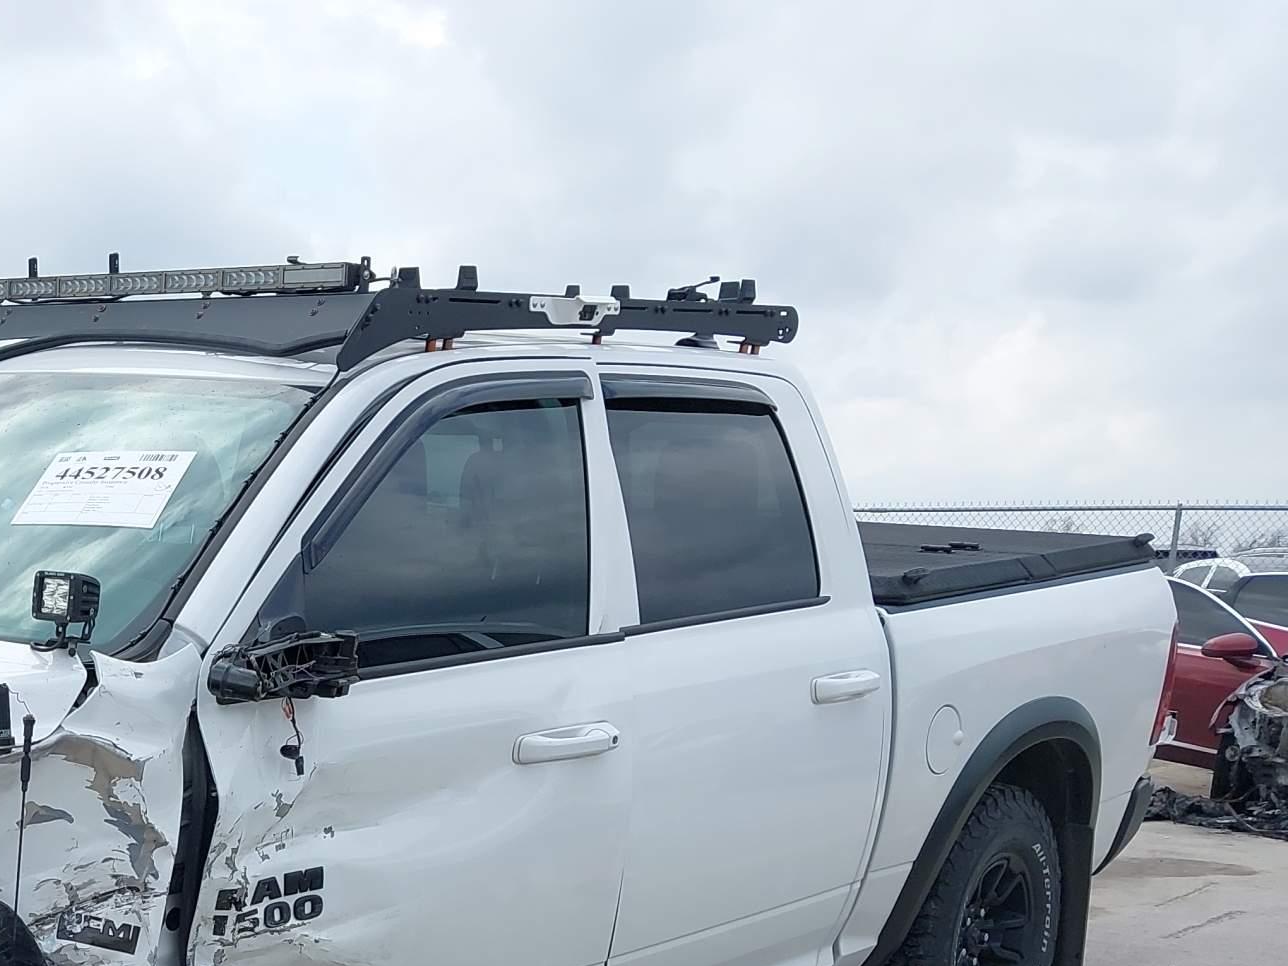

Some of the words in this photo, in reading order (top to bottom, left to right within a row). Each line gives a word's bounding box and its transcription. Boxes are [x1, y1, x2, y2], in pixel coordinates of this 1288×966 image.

[55, 466, 168, 480] 44527508
[213, 866, 324, 911] RAM
[1031, 842, 1052, 953] All-Terrain
[212, 905, 324, 936] 1500
